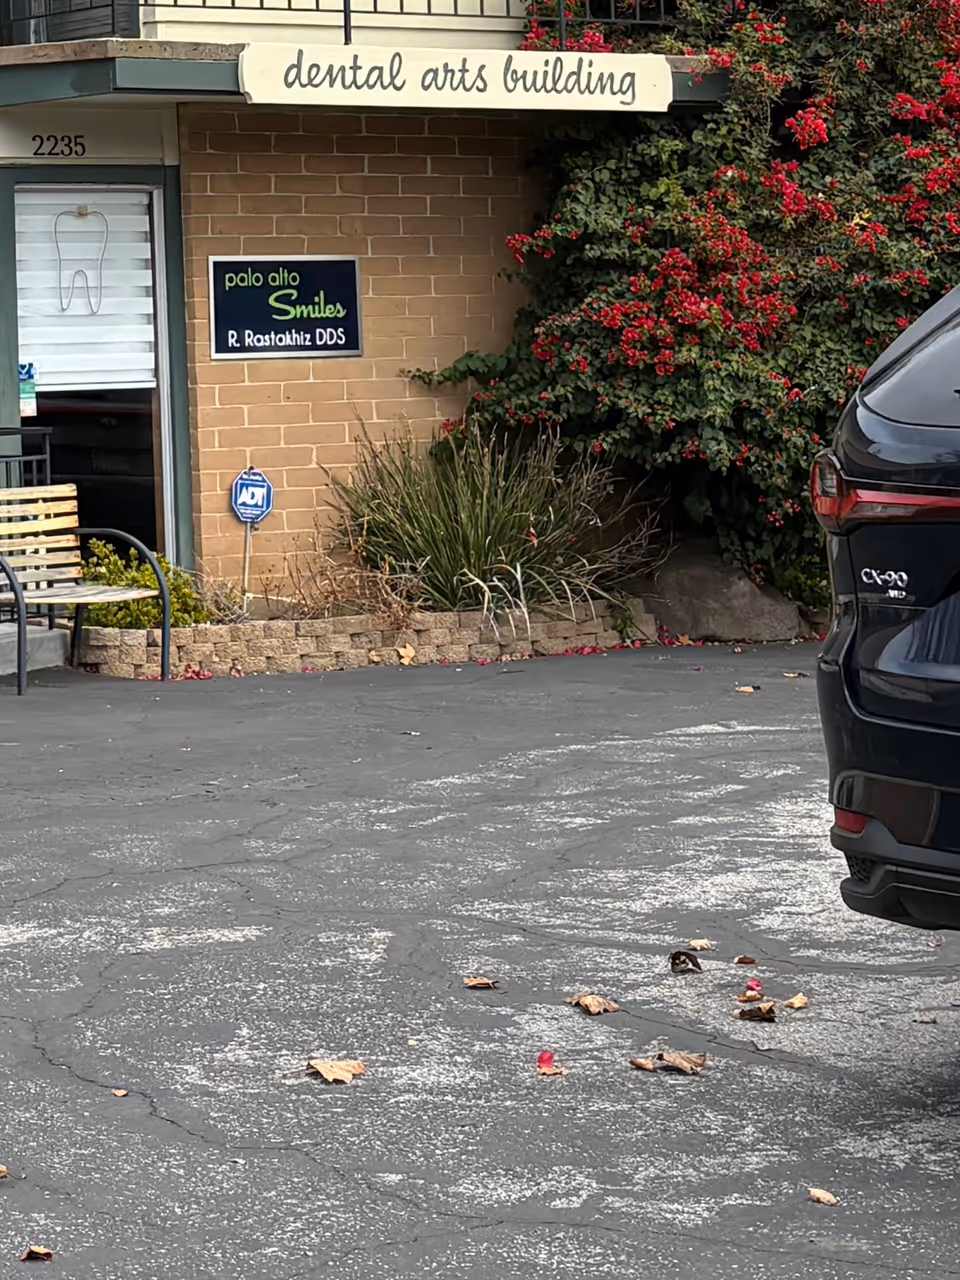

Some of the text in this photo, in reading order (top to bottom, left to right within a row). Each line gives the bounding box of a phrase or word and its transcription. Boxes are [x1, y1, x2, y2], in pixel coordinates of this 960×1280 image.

[283, 49, 637, 106] dental arts building
[31, 134, 86, 157] 2235
[225, 267, 300, 291] palo alto
[268, 289, 347, 320] Smiles
[228, 328, 346, 347] R. Rastakhiz DDS
[237, 486, 266, 506] ADT
[861, 568, 908, 588] CX-90
